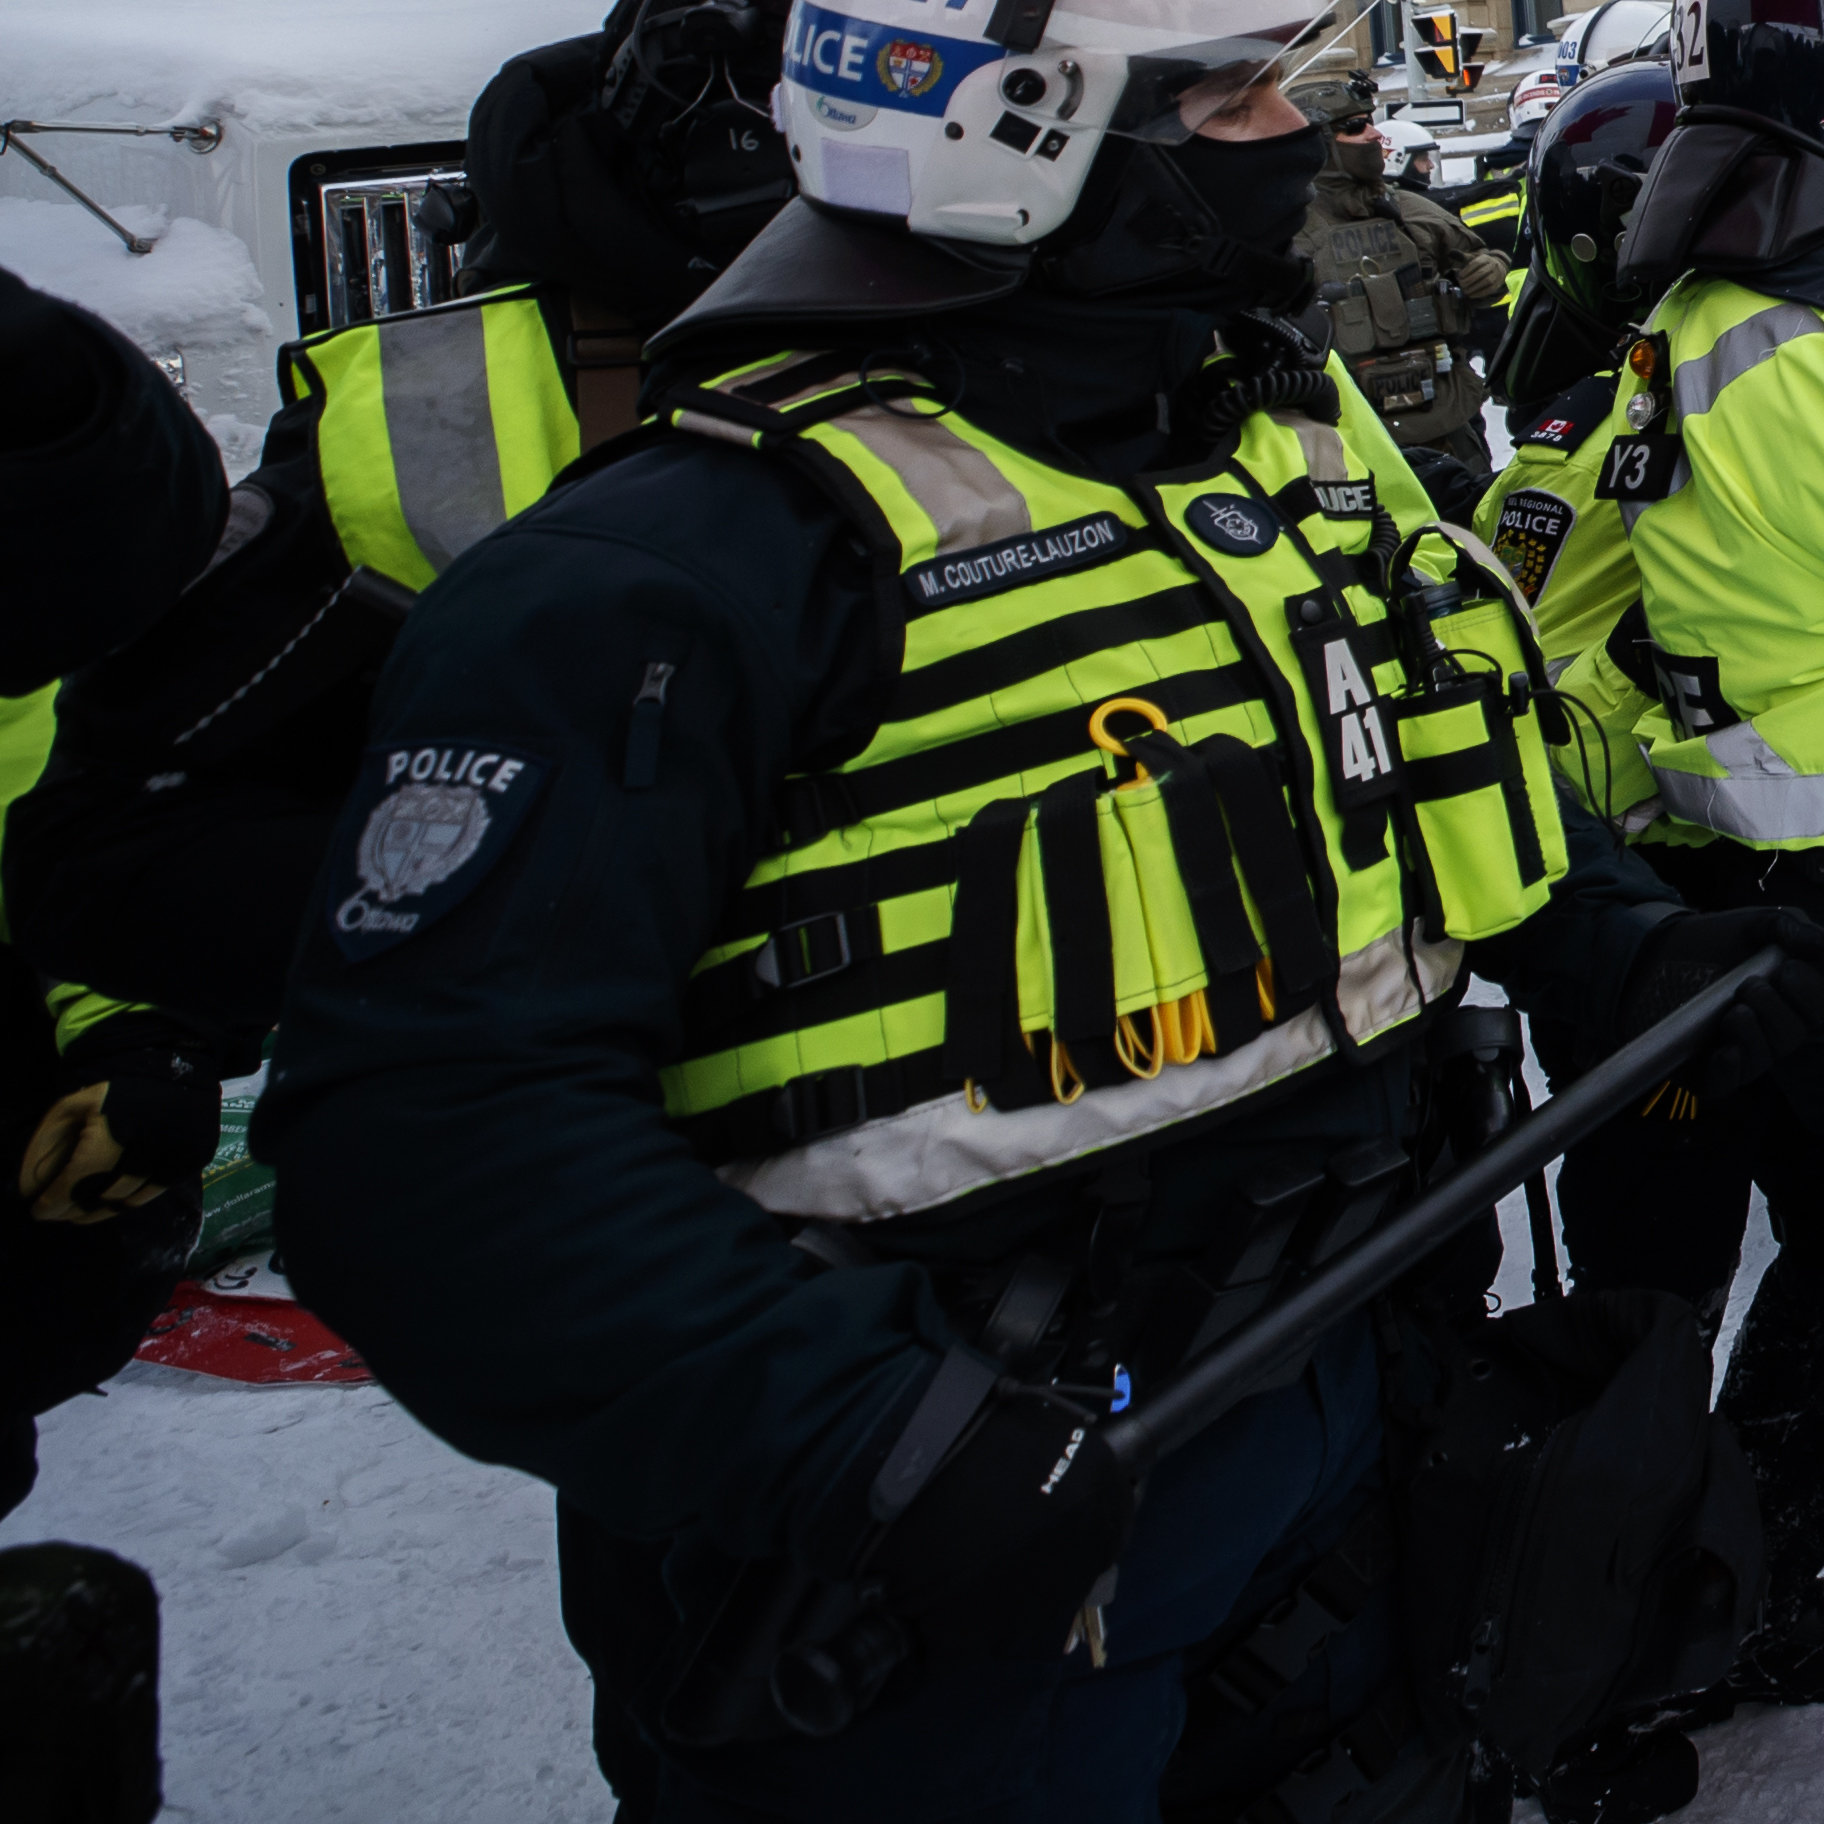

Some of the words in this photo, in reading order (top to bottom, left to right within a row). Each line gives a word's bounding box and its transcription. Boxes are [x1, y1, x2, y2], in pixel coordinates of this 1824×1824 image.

[728, 127, 760, 152] 16
[1609, 443, 1650, 490] Y3
[1501, 511, 1561, 535] POLICE
[918, 570, 946, 598] M.
[944, 519, 1115, 589] COUTURE-LAUZON
[1324, 638, 1372, 715] A
[1341, 705, 1392, 782] 41
[386, 747, 525, 792] POLICE
